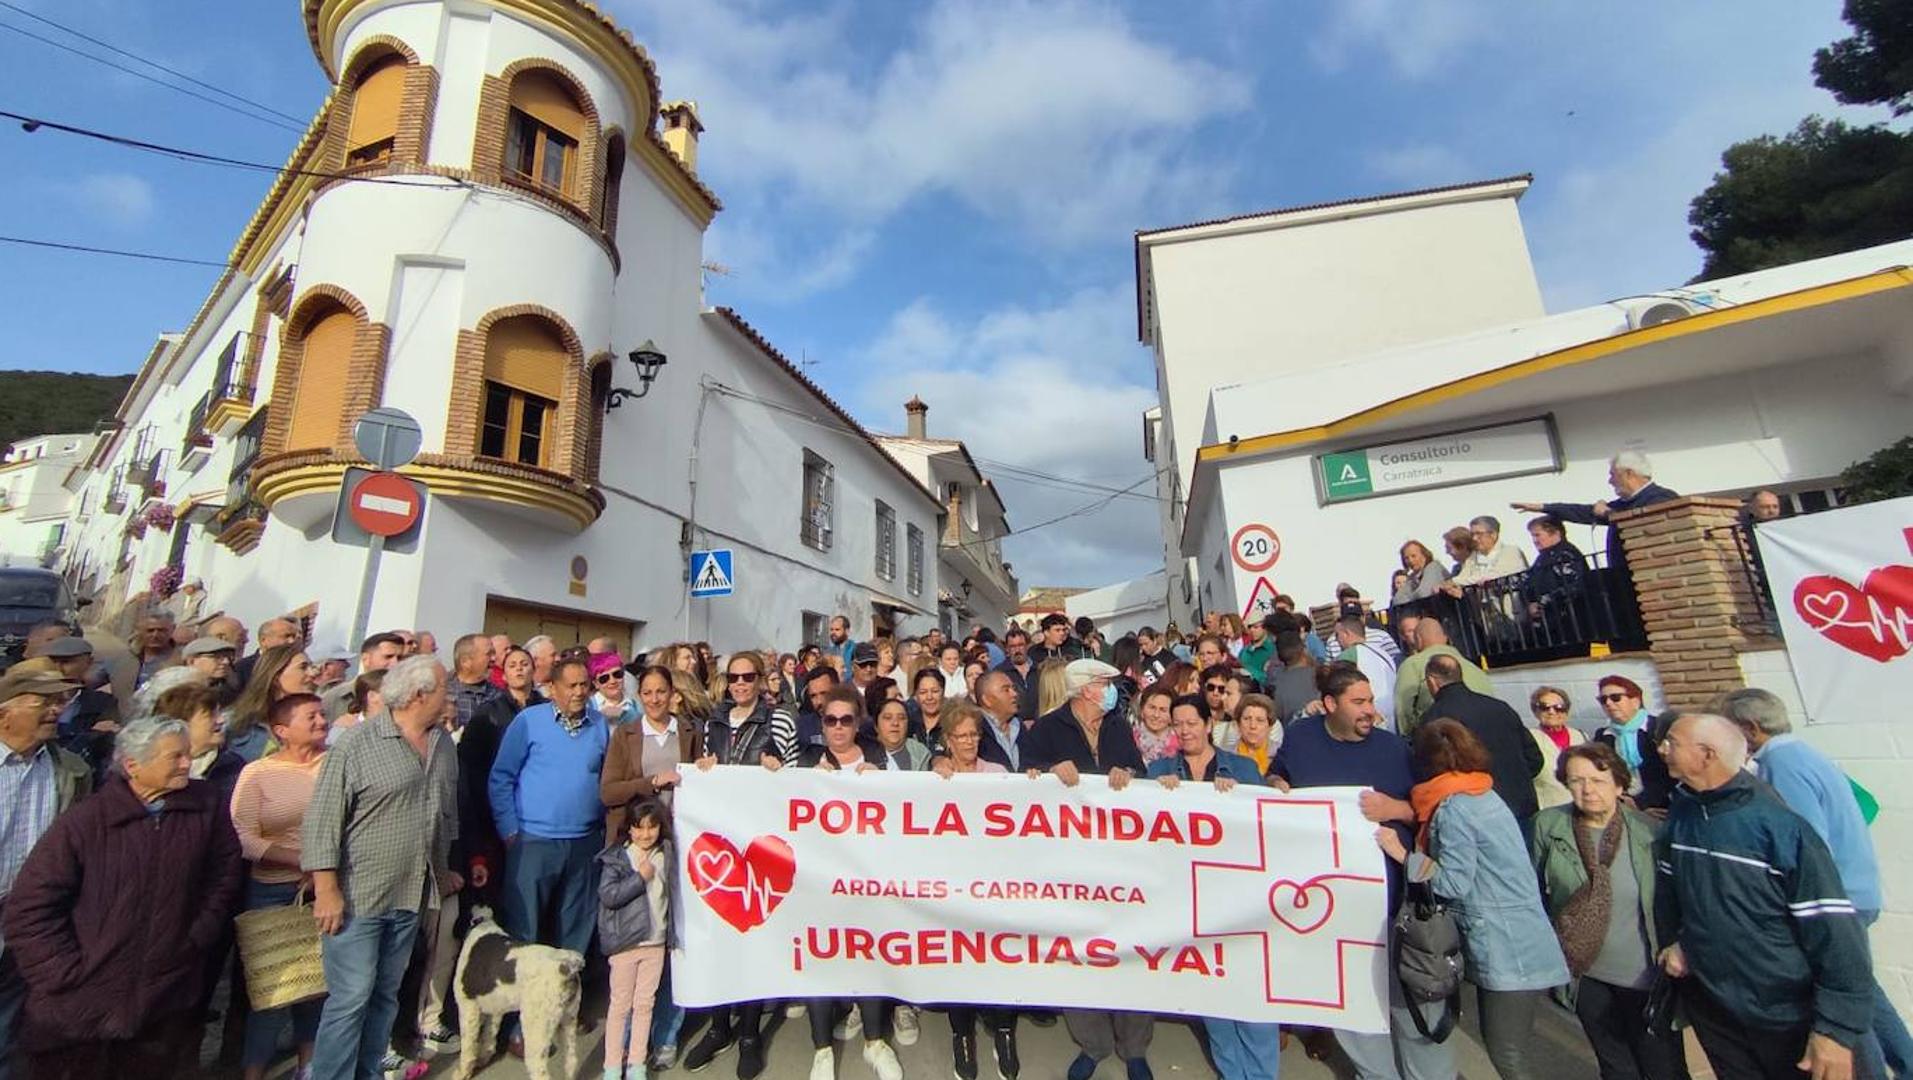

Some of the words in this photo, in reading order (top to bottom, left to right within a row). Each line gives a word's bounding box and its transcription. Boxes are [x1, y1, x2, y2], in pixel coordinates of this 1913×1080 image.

[1380, 439, 1471, 465] Consultorio
[1383, 467, 1442, 482] Carratraca
[1243, 538, 1267, 557] 20
[788, 797, 888, 836] POR
[902, 800, 968, 837] LA
[983, 801, 1224, 847] SANIDAD
[832, 878, 948, 899] ARDALES
[969, 880, 1146, 904] CARRATRACA
[793, 925, 1120, 972] ¡URGENCIAS
[1133, 942, 1225, 978] YA!
